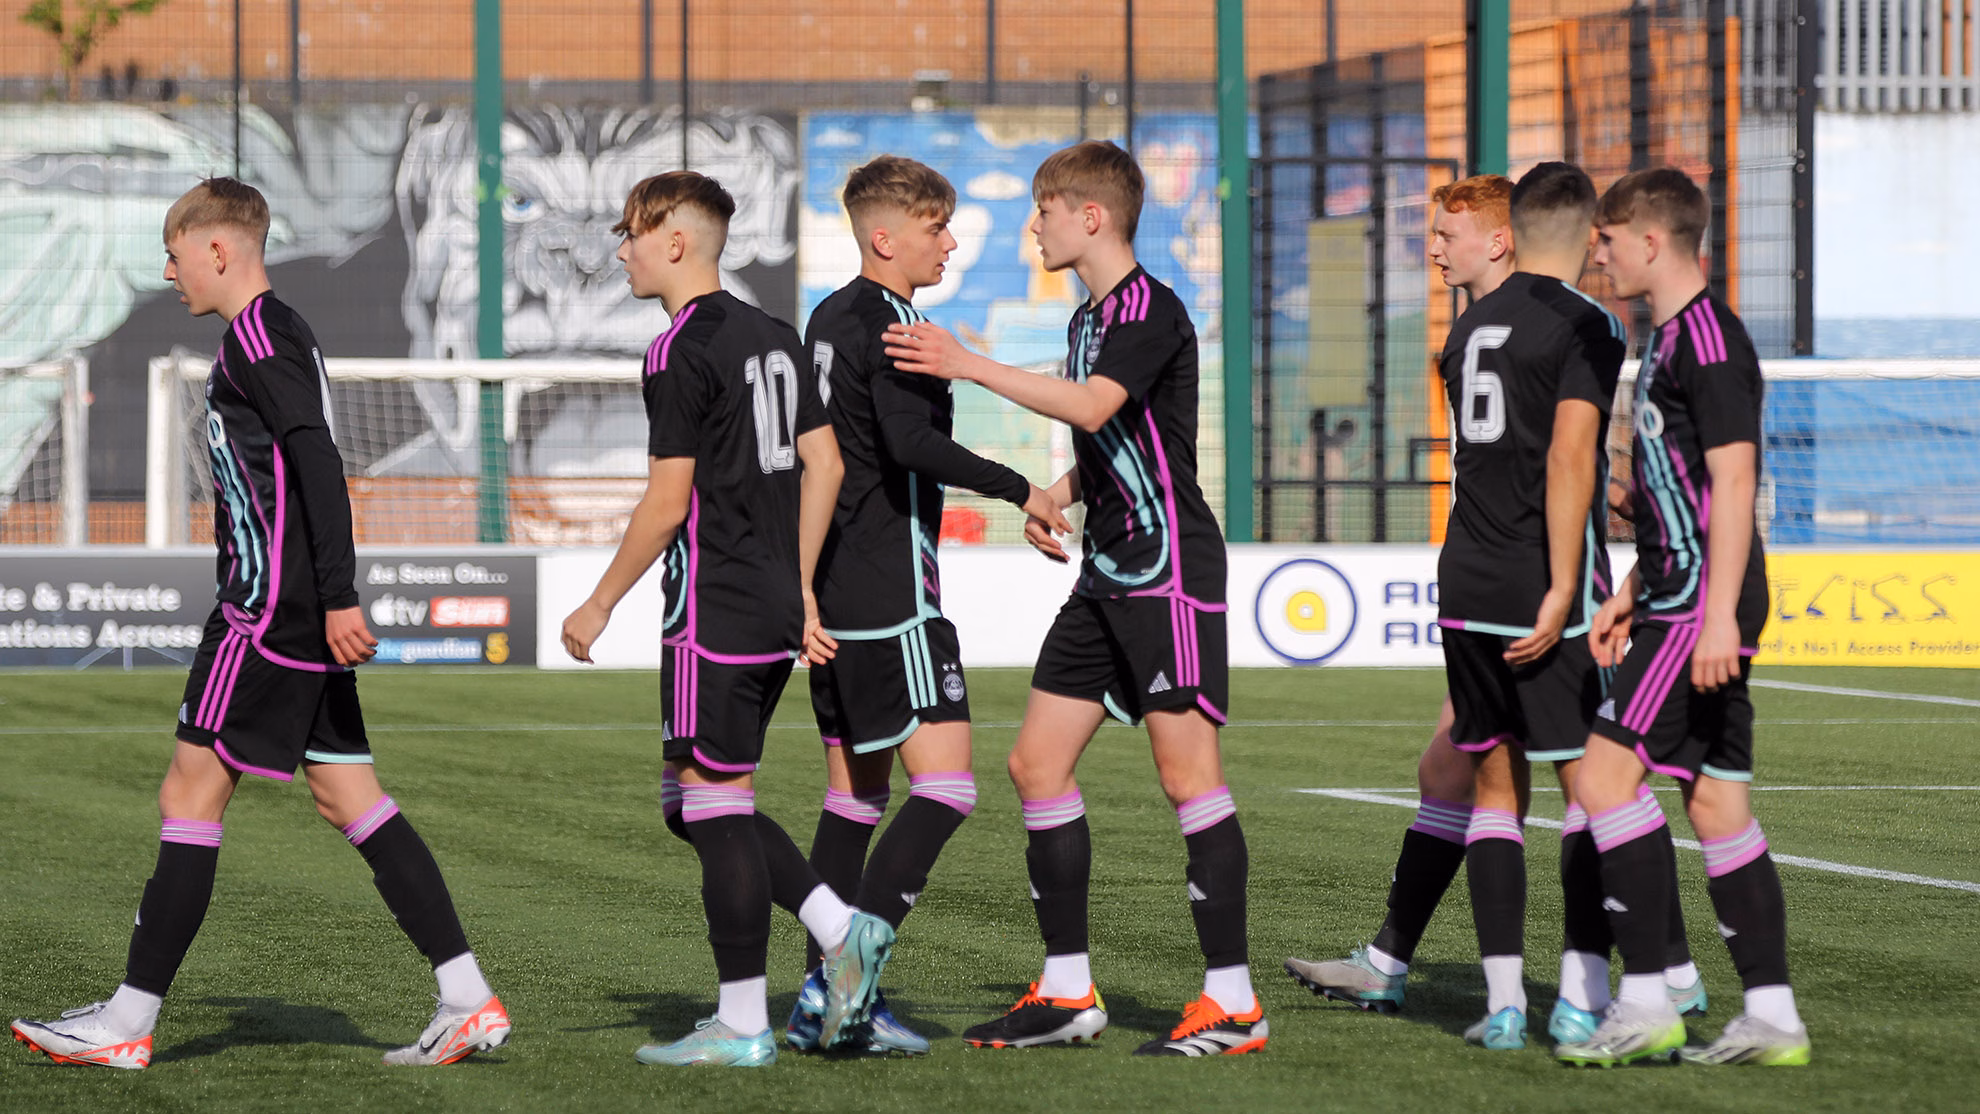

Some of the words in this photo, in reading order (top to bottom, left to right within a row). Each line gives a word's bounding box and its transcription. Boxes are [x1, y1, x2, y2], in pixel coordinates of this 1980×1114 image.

[1462, 326, 1512, 443] 6
[744, 349, 798, 474] 10
[367, 563, 397, 584] As
[399, 563, 453, 584] Seen
[32, 582, 62, 611] &
[66, 581, 182, 611] Private
[96, 619, 203, 648] Across
[486, 632, 510, 664] 5
[1847, 641, 1903, 656] Access
